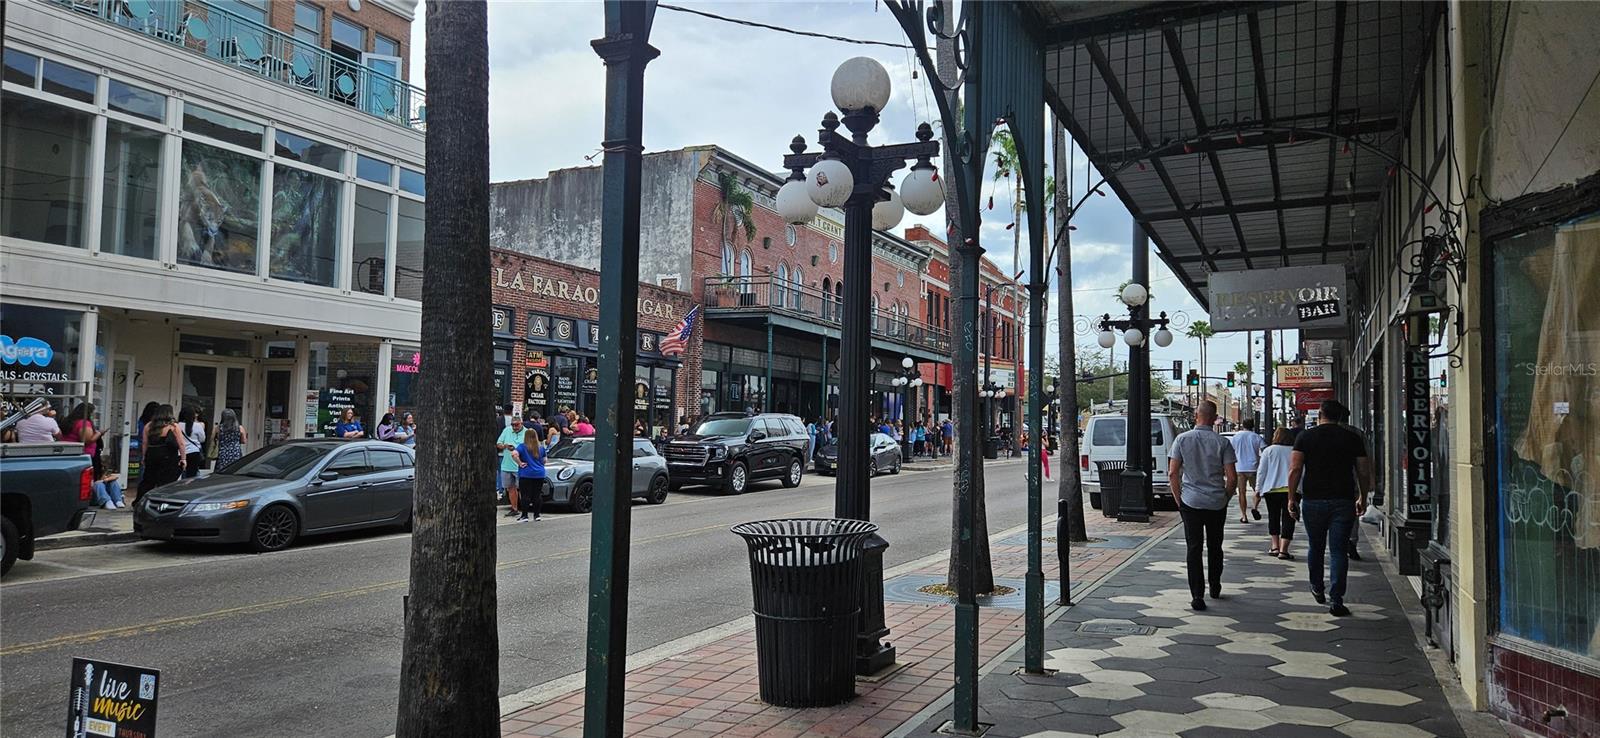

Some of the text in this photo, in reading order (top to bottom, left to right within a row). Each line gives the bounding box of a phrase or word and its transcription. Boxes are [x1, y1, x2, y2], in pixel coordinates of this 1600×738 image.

[822, 221, 842, 236] GRANT
[496, 267, 674, 320] LA FARAO IGAR
[1299, 303, 1337, 319] BAR
[528, 351, 543, 359] ATM
[23, 371, 68, 381] CRYSTALS
[396, 364, 420, 374] MARCOL
[1411, 504, 1432, 513] BAR
[99, 669, 132, 700] live
[93, 697, 146, 722] music
[89, 721, 113, 734] EVERY
